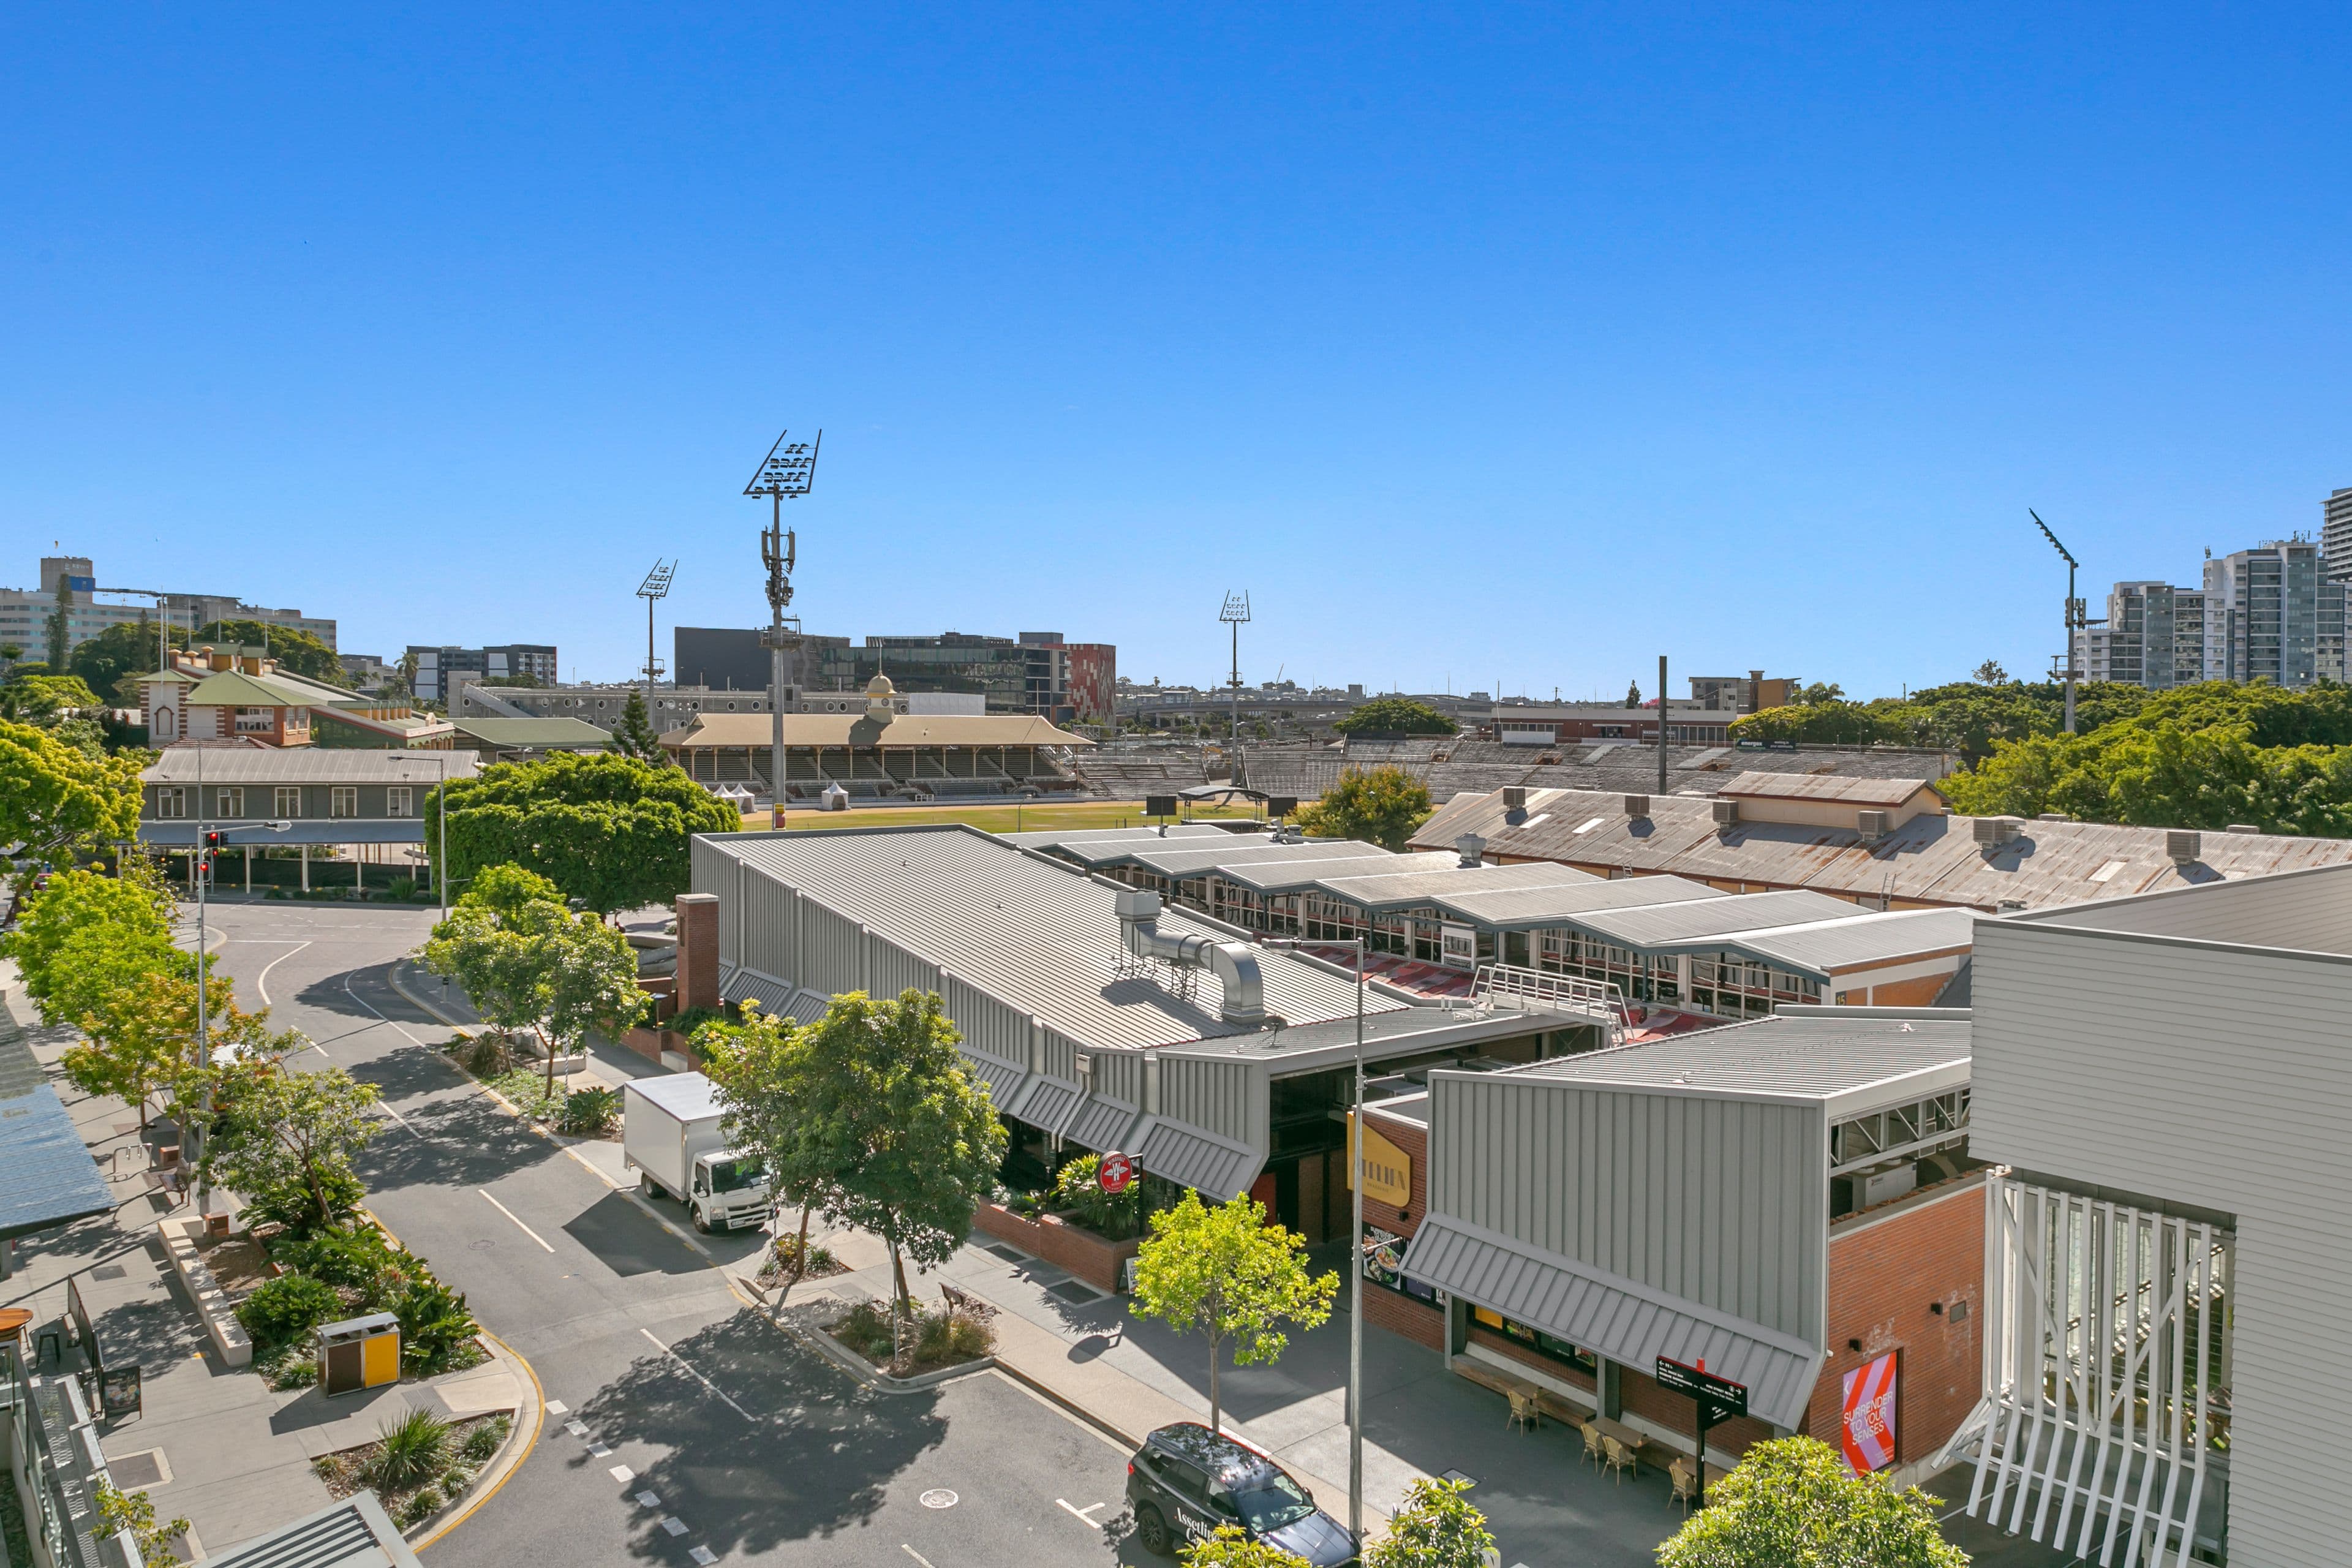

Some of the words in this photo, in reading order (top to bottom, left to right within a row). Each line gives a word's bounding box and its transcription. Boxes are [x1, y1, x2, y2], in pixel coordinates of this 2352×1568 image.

[1843, 1391, 1893, 1425] SURRENDER
[1850, 1419, 1862, 1433] TO
[1864, 1406, 1887, 1427] YOUR
[1852, 1420, 1885, 1446] SENSES
